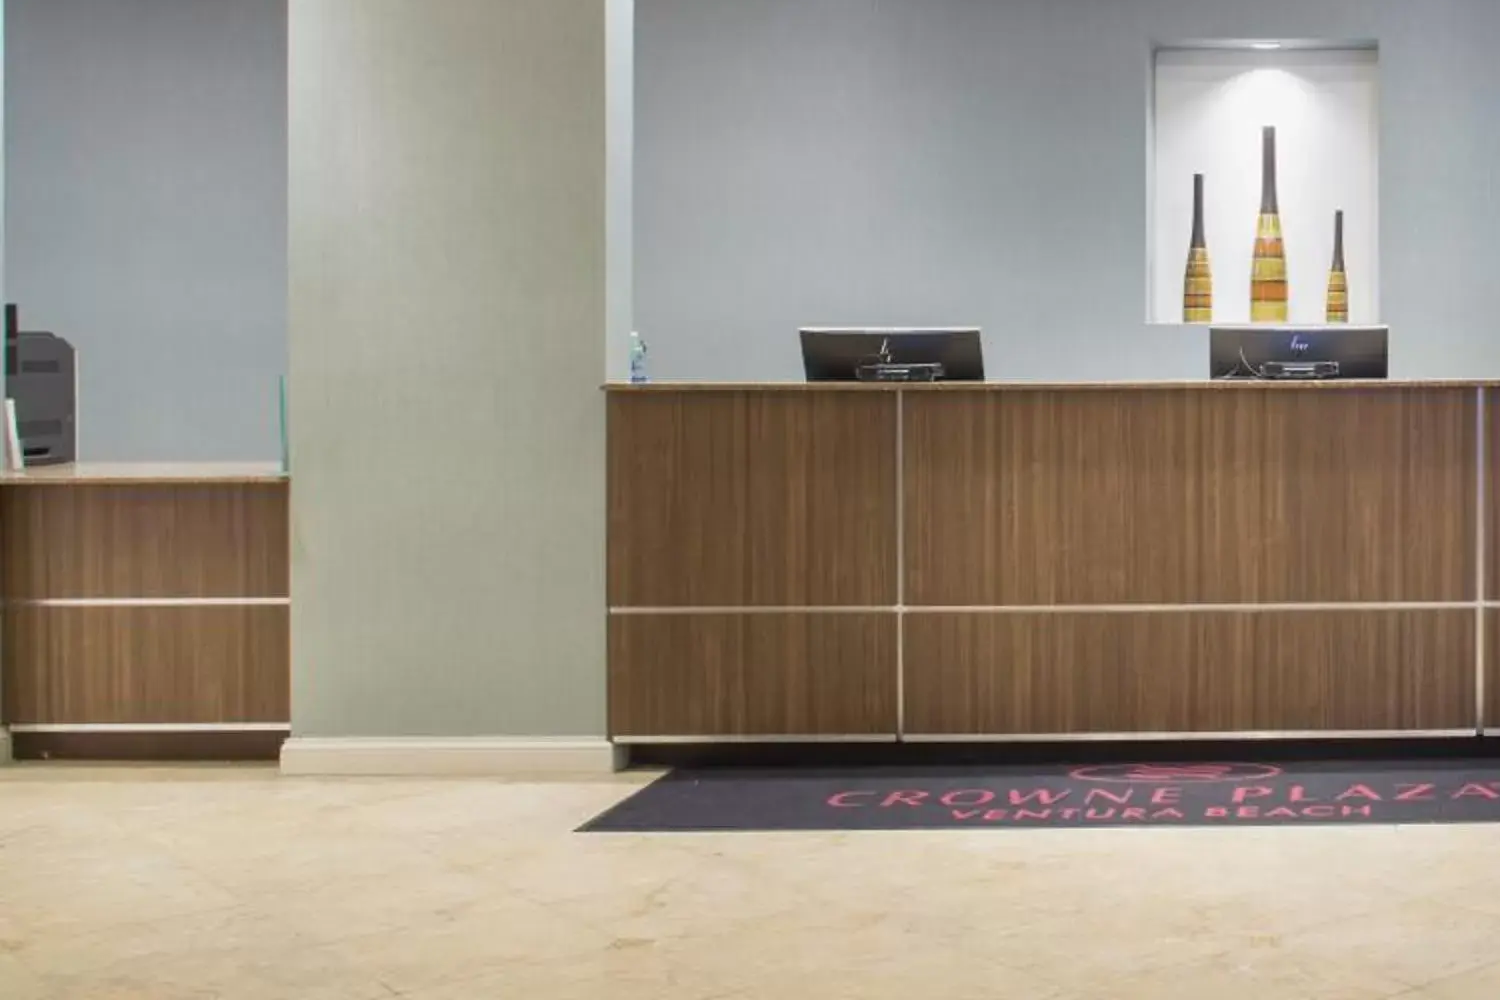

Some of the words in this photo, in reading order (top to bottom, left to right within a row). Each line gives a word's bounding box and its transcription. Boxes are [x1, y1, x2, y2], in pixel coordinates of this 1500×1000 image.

[826, 786, 1184, 807] CROWNE
[951, 807, 1185, 820] VENTURA
[1203, 804, 1373, 818] BEACH
